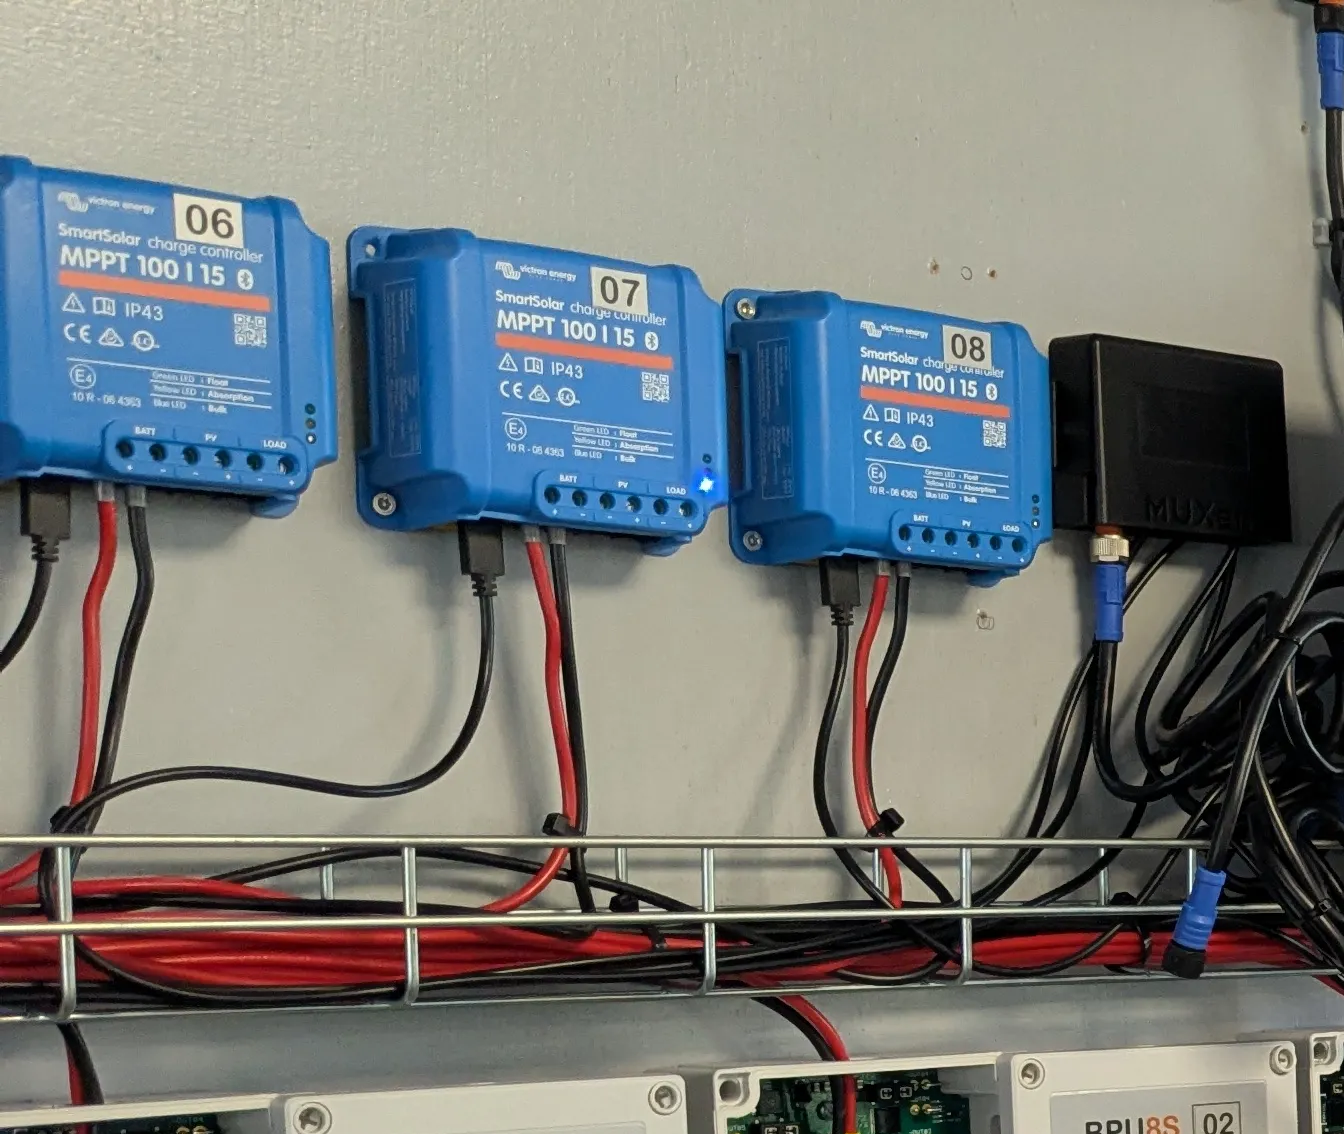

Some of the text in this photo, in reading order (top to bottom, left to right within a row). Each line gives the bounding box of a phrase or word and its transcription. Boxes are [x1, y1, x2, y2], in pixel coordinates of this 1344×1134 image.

[88, 196, 155, 215] victron energy
[185, 204, 234, 239] 06
[58, 223, 263, 264] SmartSolar charge controller
[60, 244, 225, 286] MPPT 100 15
[520, 265, 577, 282] victron energy
[600, 276, 640, 307] 07
[125, 302, 164, 321] IP43
[495, 289, 565, 311] SmartSolar
[570, 301, 612, 320] charge
[497, 310, 635, 348] MPPT 100 15
[881, 324, 929, 340] victron energy
[951, 333, 985, 362] 08
[860, 346, 919, 365] SmartSolar
[923, 357, 958, 373] charge
[551, 361, 584, 380] IP43
[862, 365, 978, 398] MPPT 100 15
[907, 412, 934, 427] IP43
[134, 425, 156, 436] BATT
[263, 439, 287, 450] LOAD
[559, 474, 577, 484] BATT
[618, 481, 628, 489] PV
[666, 486, 687, 495] LOAD
[913, 514, 929, 523] BATT
